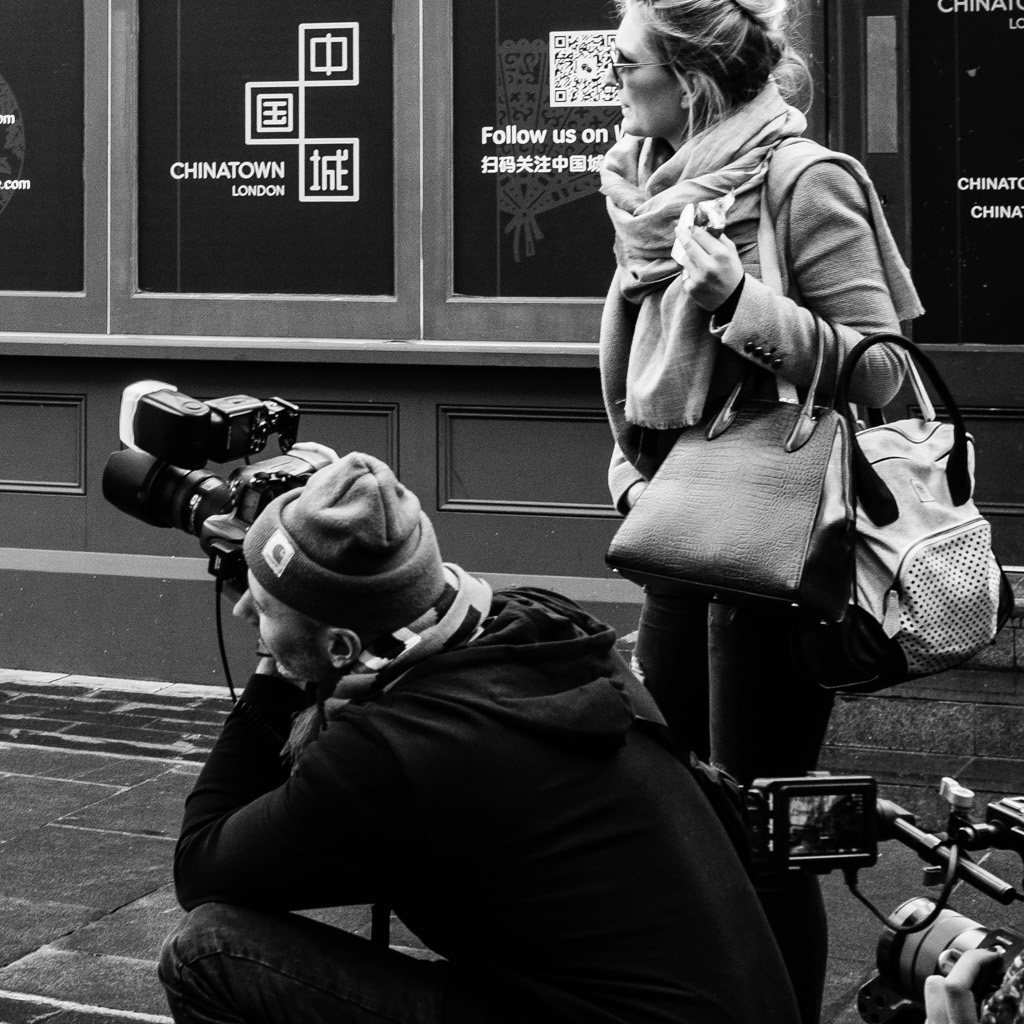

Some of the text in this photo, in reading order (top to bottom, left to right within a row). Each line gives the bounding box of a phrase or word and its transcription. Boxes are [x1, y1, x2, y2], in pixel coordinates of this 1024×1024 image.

[481, 124, 547, 145] Follow
[552, 128, 577, 144] us
[581, 127, 608, 144] on
[169, 160, 285, 180] CHINATOWN
[231, 184, 285, 197] LONDON
[970, 205, 1024, 219] CHINA
